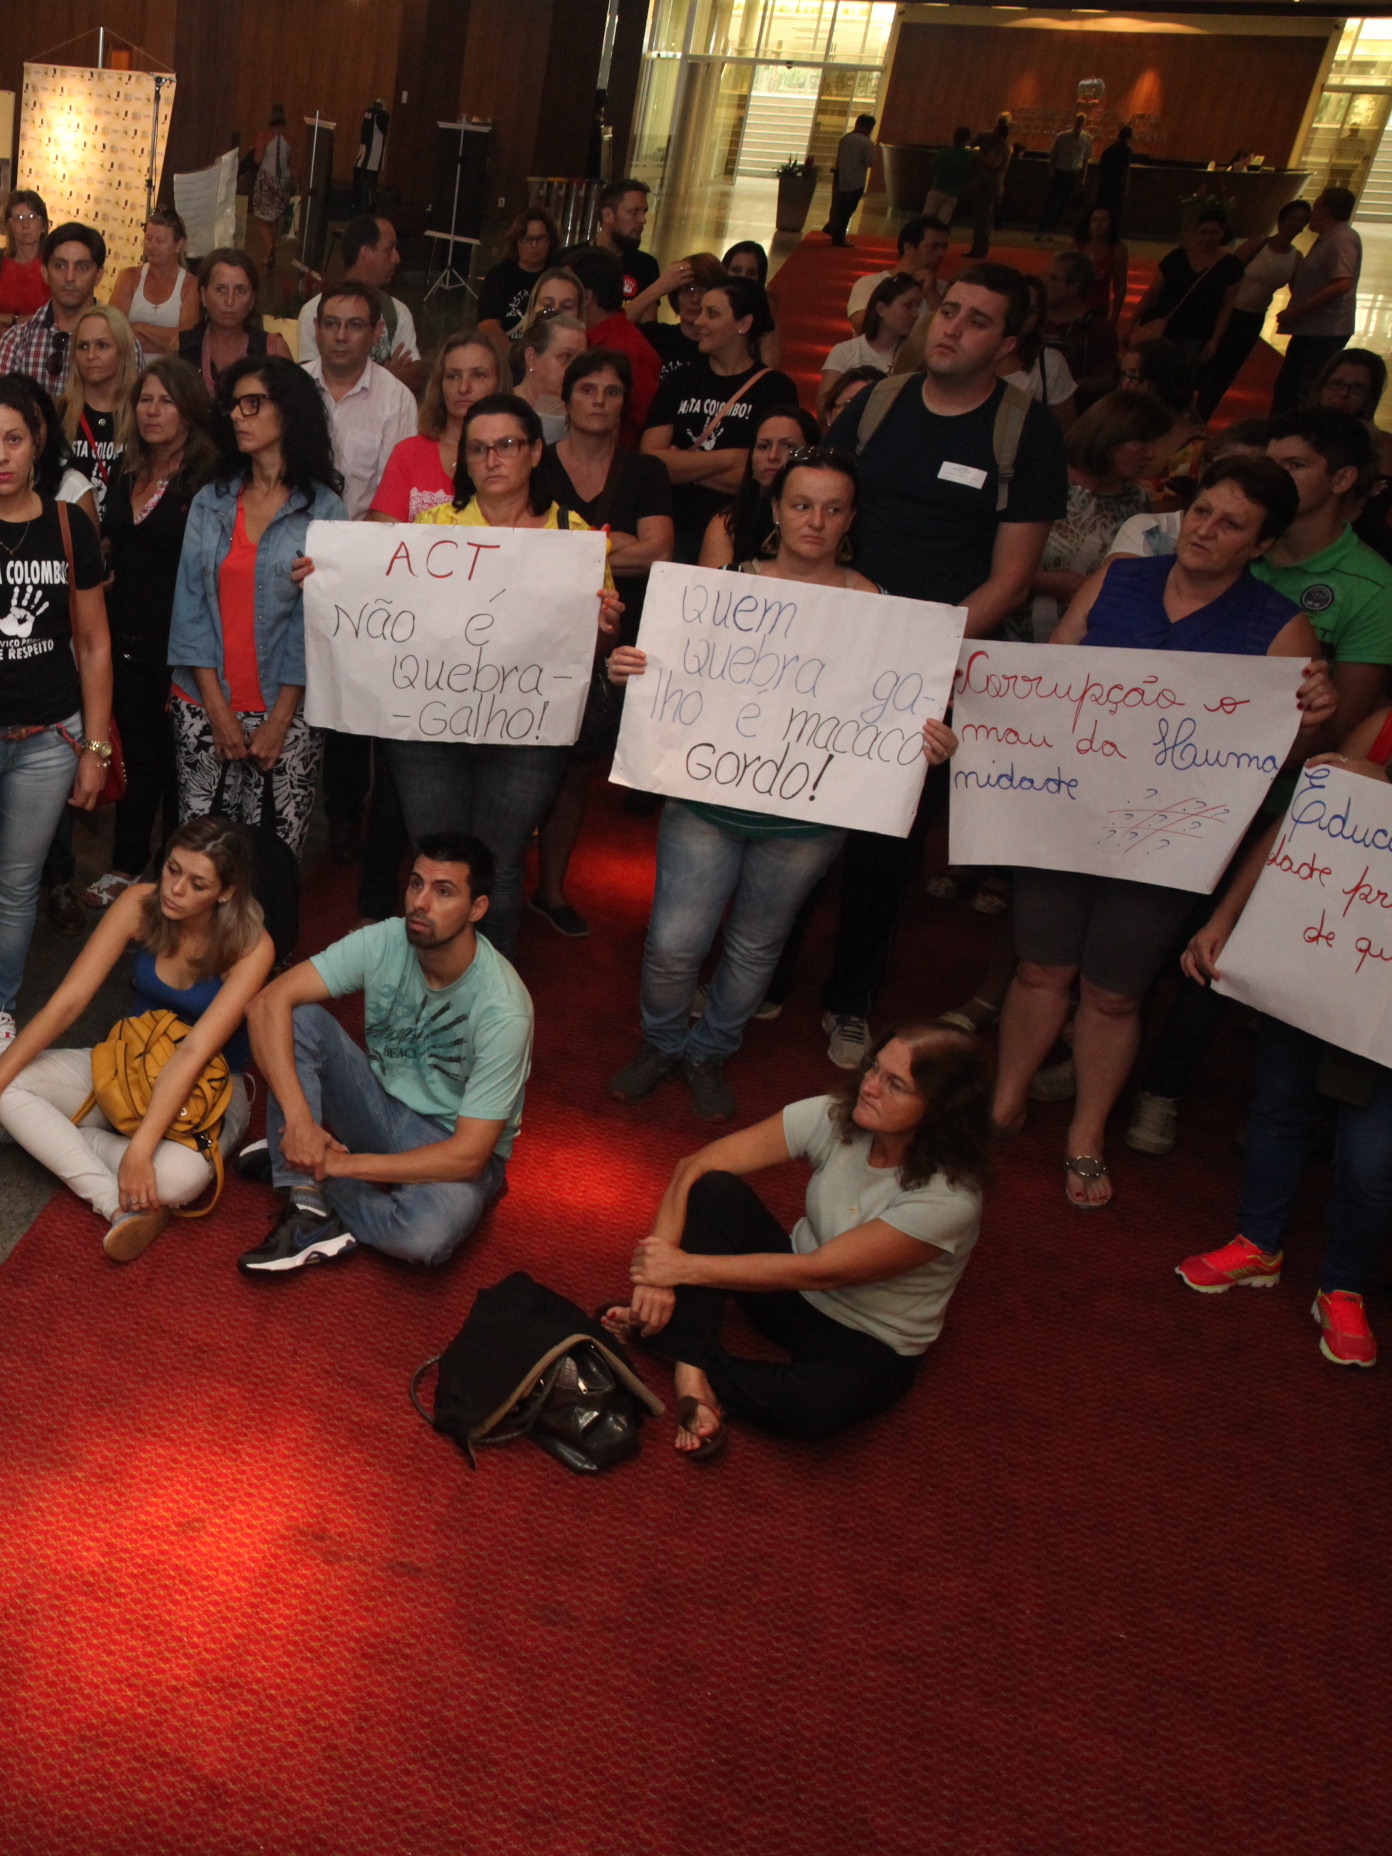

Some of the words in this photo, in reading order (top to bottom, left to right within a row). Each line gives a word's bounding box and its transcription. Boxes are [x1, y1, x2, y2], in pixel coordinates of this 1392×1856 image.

[385, 539, 501, 581] ACT
[332, 598, 416, 643] Não
[464, 588, 506, 647] é
[681, 584, 798, 639] Quem
[8, 639, 54, 660] RESPEITO
[683, 632, 826, 698] Quebra
[782, 707, 925, 766] macaco
[962, 723, 1054, 749] mau
[1076, 719, 1128, 759] da
[685, 742, 835, 802] Gordo!
[954, 759, 1079, 801] nidade
[1302, 908, 1336, 949] de
